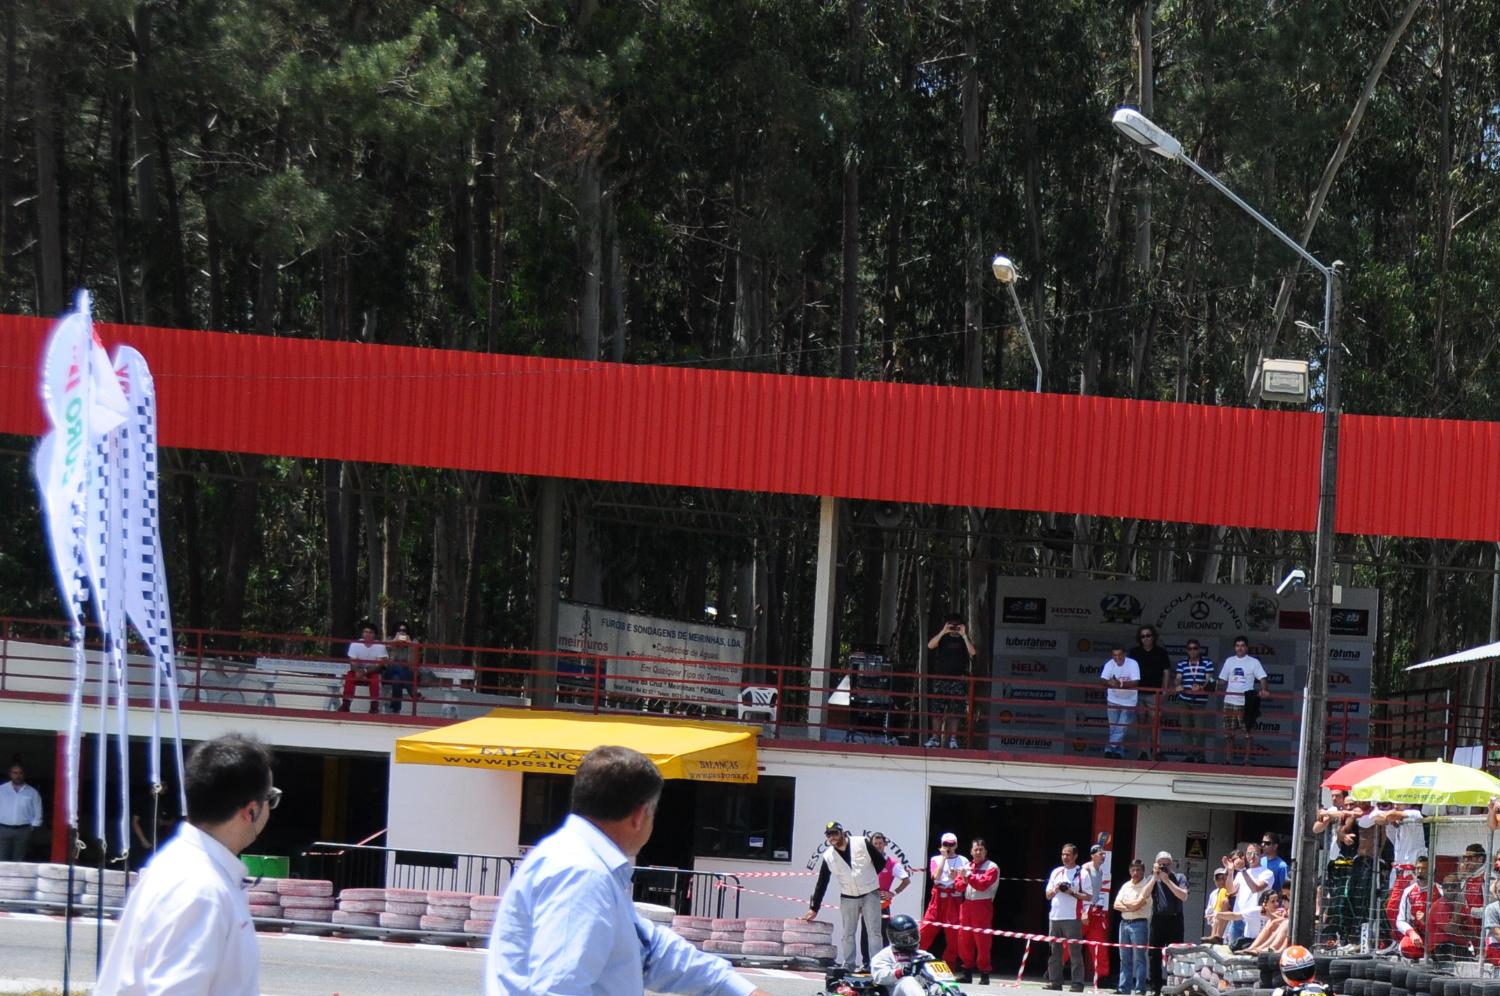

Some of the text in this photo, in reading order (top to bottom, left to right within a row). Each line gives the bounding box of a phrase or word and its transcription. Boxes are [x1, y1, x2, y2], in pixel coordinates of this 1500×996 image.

[1106, 595, 1130, 611] 24
[1156, 592, 1193, 628] ESCOLA
[1200, 592, 1243, 629] KARTING
[1050, 607, 1092, 615] HONDA
[601, 618, 625, 631] FUROS
[633, 625, 677, 640] SONDAGENS
[677, 631, 688, 641] DE
[1177, 621, 1225, 630] EUROINDY
[700, 687, 725, 698] POMBAL
[443, 756, 579, 771] www.pestro
